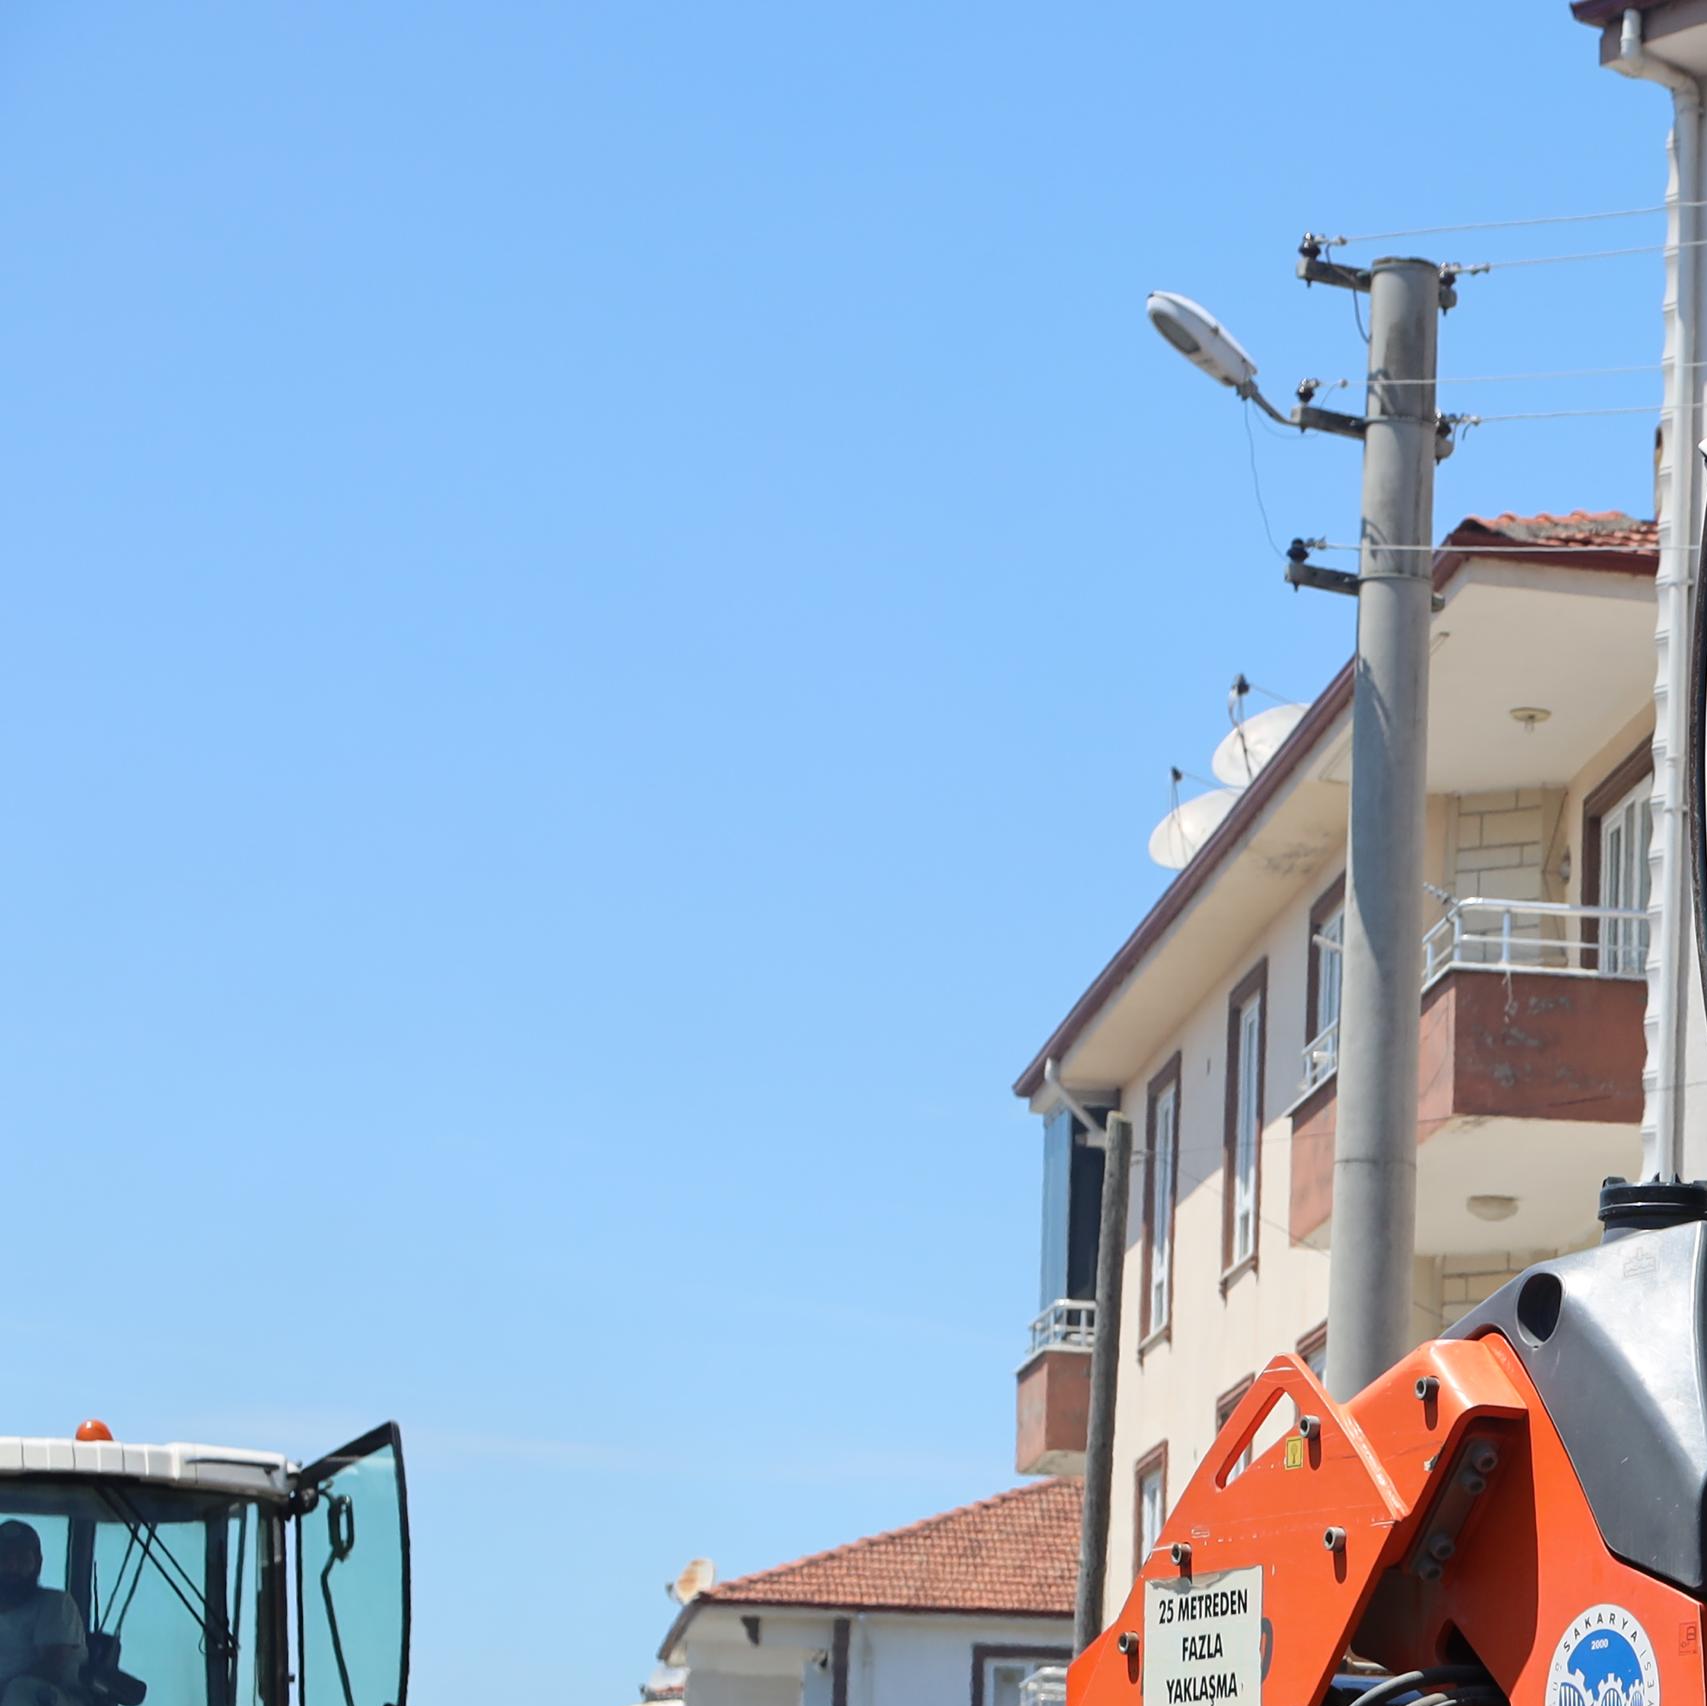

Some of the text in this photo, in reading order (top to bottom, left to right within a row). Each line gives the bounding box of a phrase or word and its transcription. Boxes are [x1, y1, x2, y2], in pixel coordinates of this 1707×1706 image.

[1158, 1588, 1248, 1625] 25 METREDEN
[1181, 1632, 1224, 1663] FAZLA
[1563, 1612, 1640, 1653] SAKARYA
[1591, 1638, 1609, 1651] 2000
